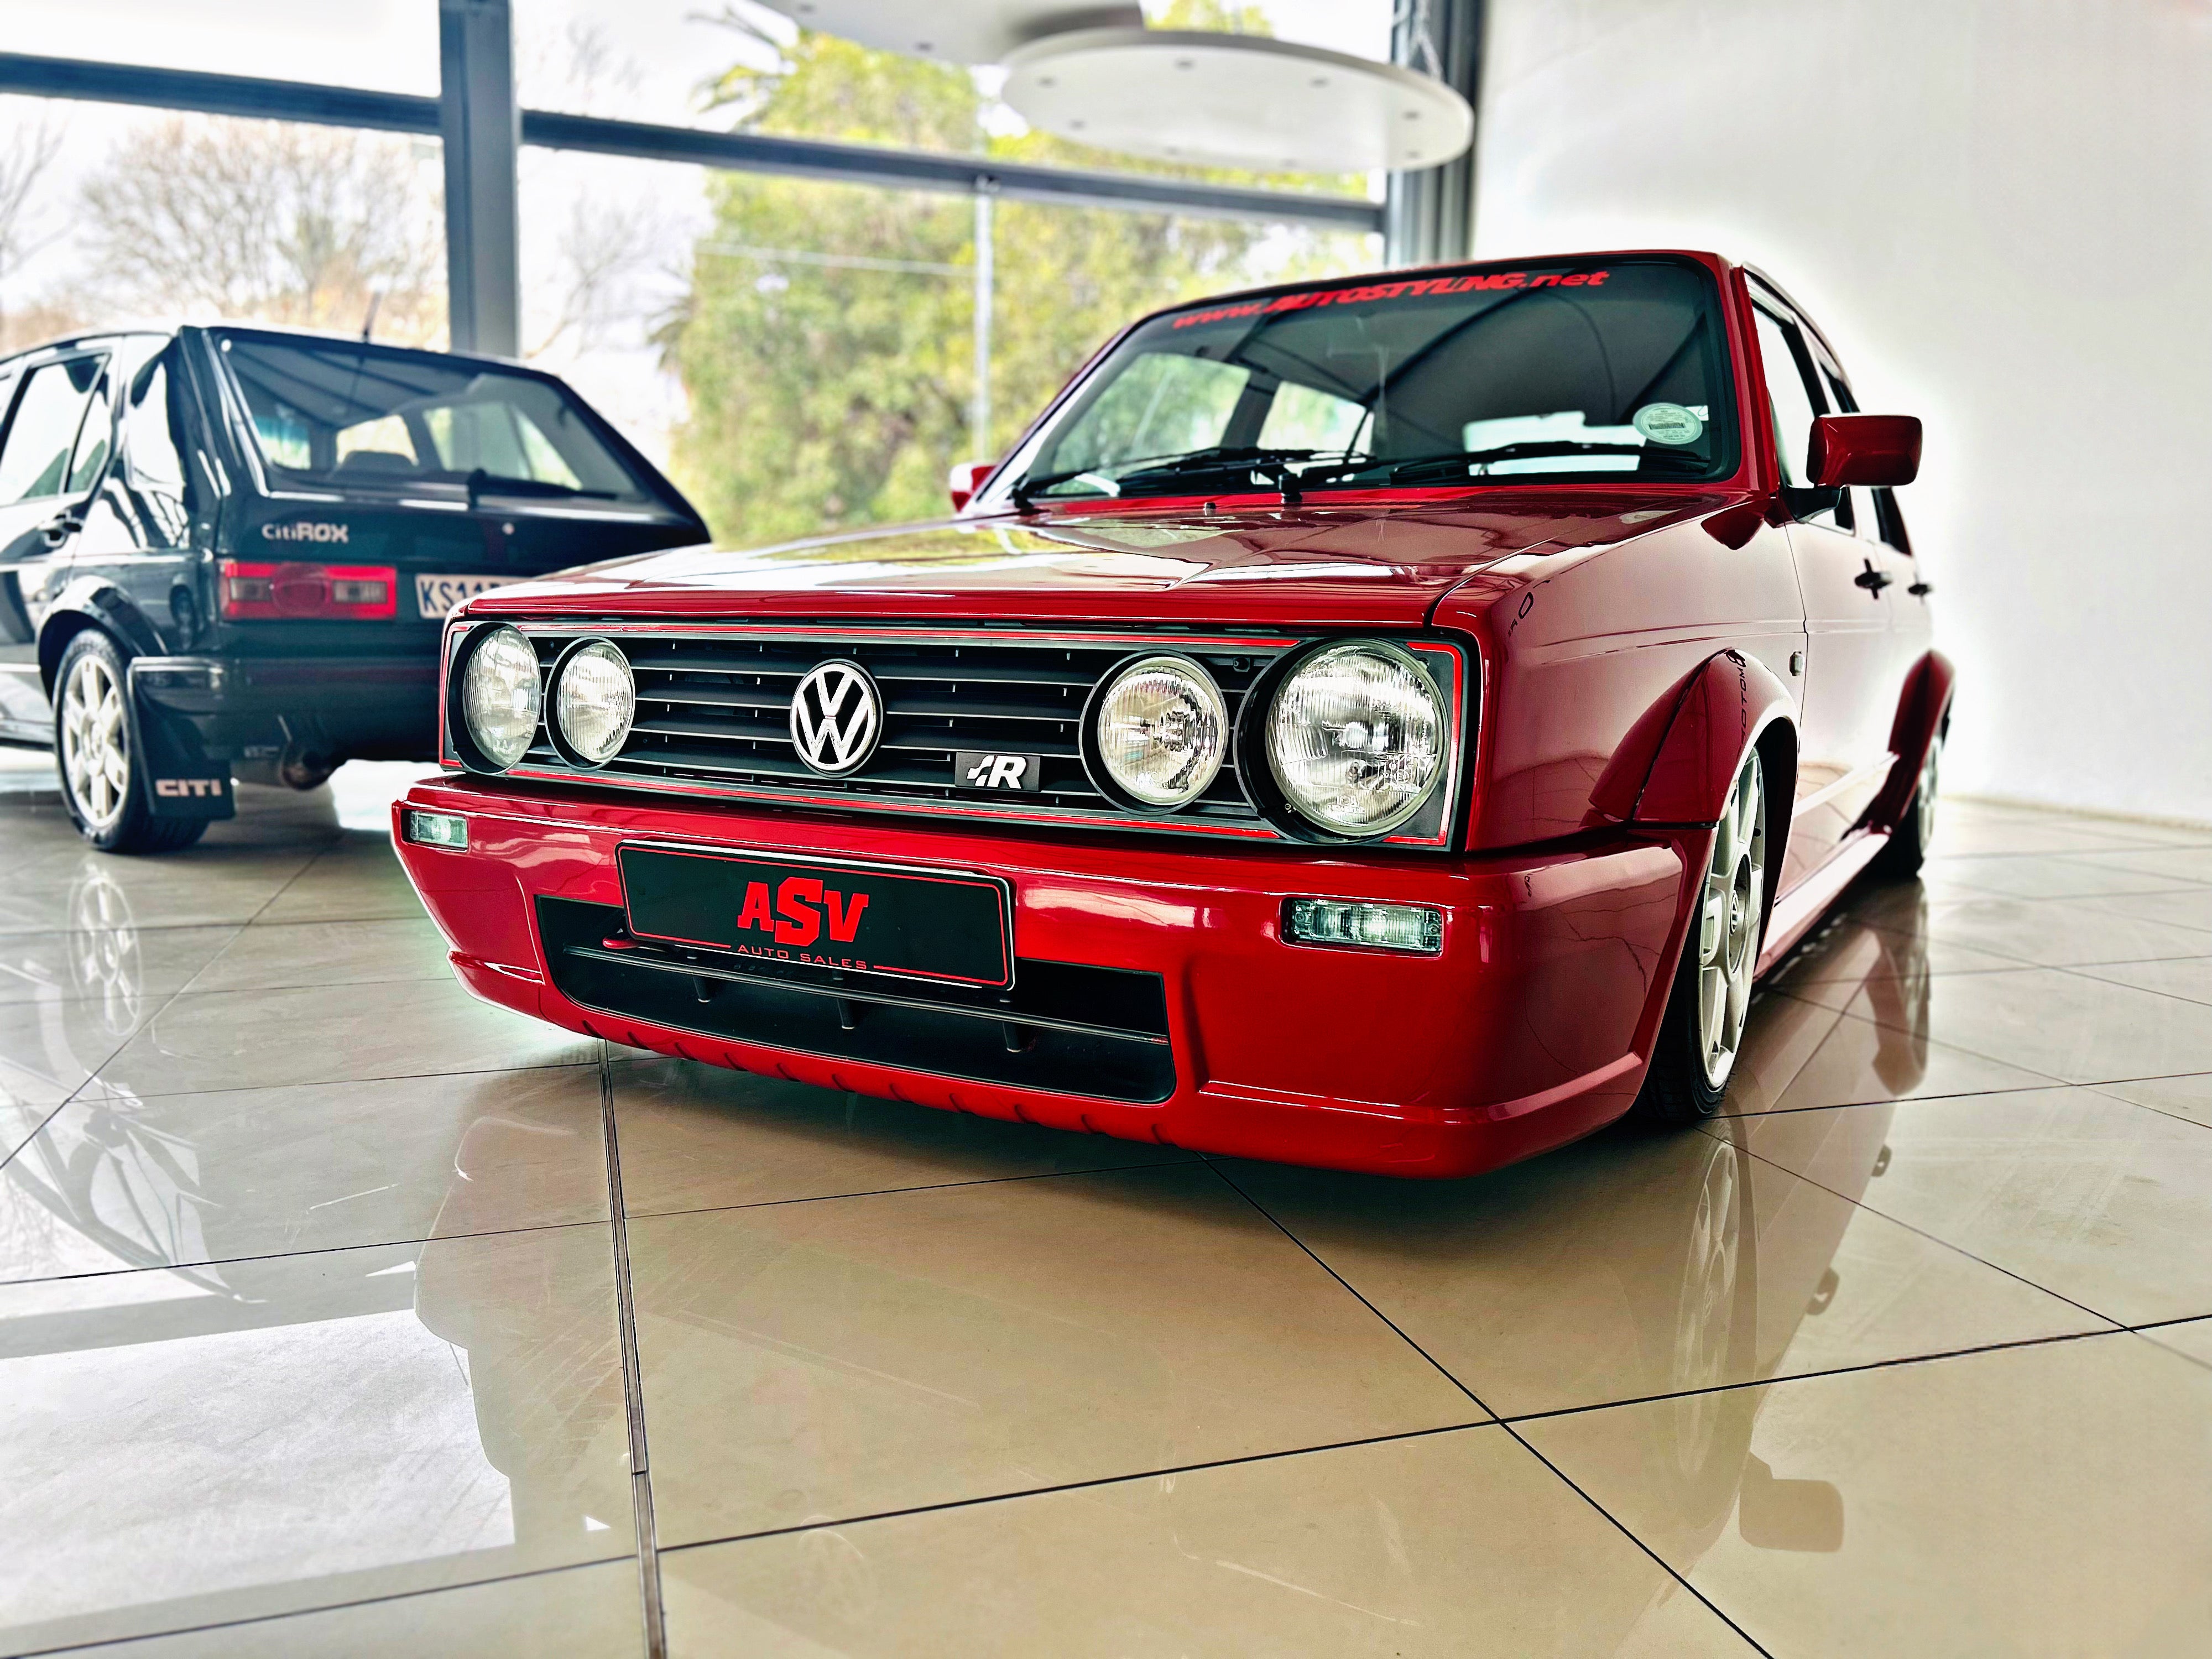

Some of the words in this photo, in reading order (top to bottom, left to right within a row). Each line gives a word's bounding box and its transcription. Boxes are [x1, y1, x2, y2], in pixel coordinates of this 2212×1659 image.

[1173, 270, 1610, 329] www.AUTOSTYLING.net
[262, 521, 348, 544] CitiROX
[155, 779, 222, 797] CITI
[737, 877, 869, 947] ASV
[738, 944, 789, 959] AUTO
[800, 953, 867, 970] SALES
